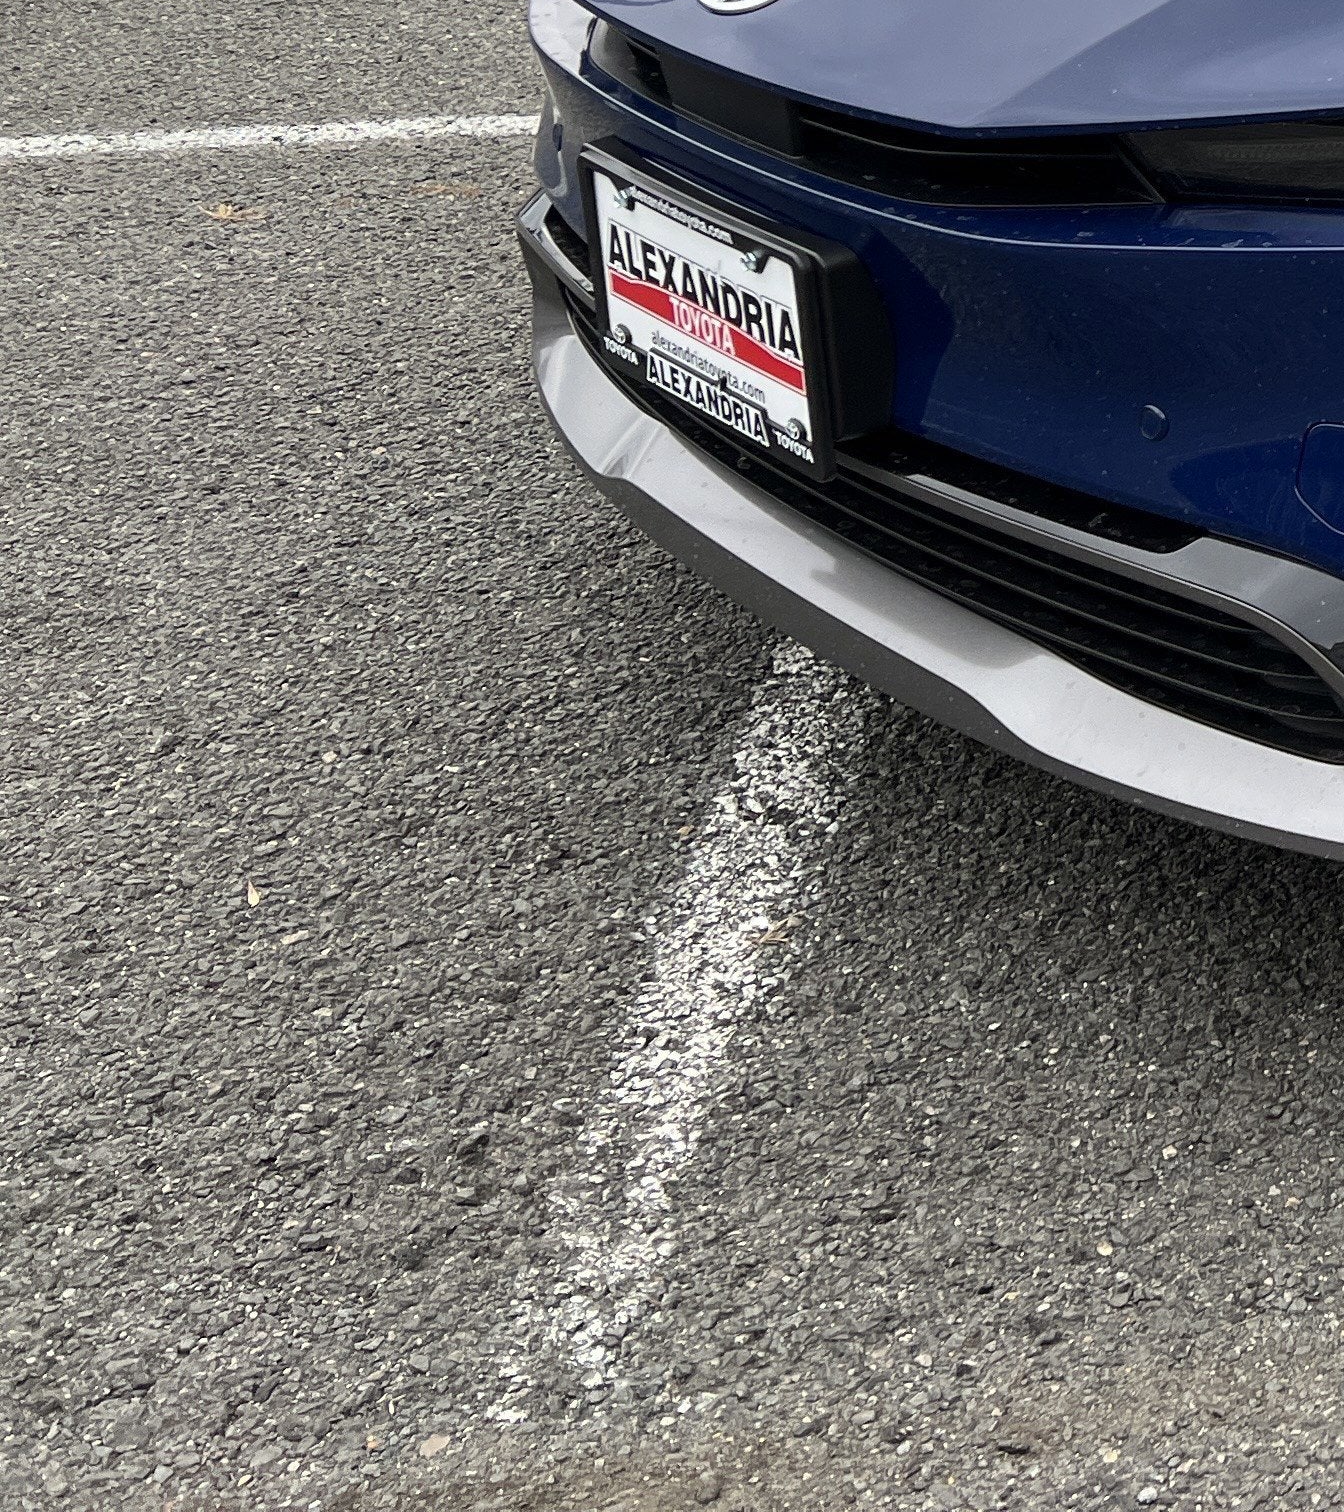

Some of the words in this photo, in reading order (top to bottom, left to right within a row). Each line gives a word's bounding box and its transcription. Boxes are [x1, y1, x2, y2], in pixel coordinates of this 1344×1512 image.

[607, 224, 802, 360] ALEXANDRIA
[603, 336, 639, 365] TOYOTA
[669, 297, 736, 357] TOYOTA
[649, 353, 768, 445] ALEXANDRIA
[772, 429, 815, 464] TOYOTA
